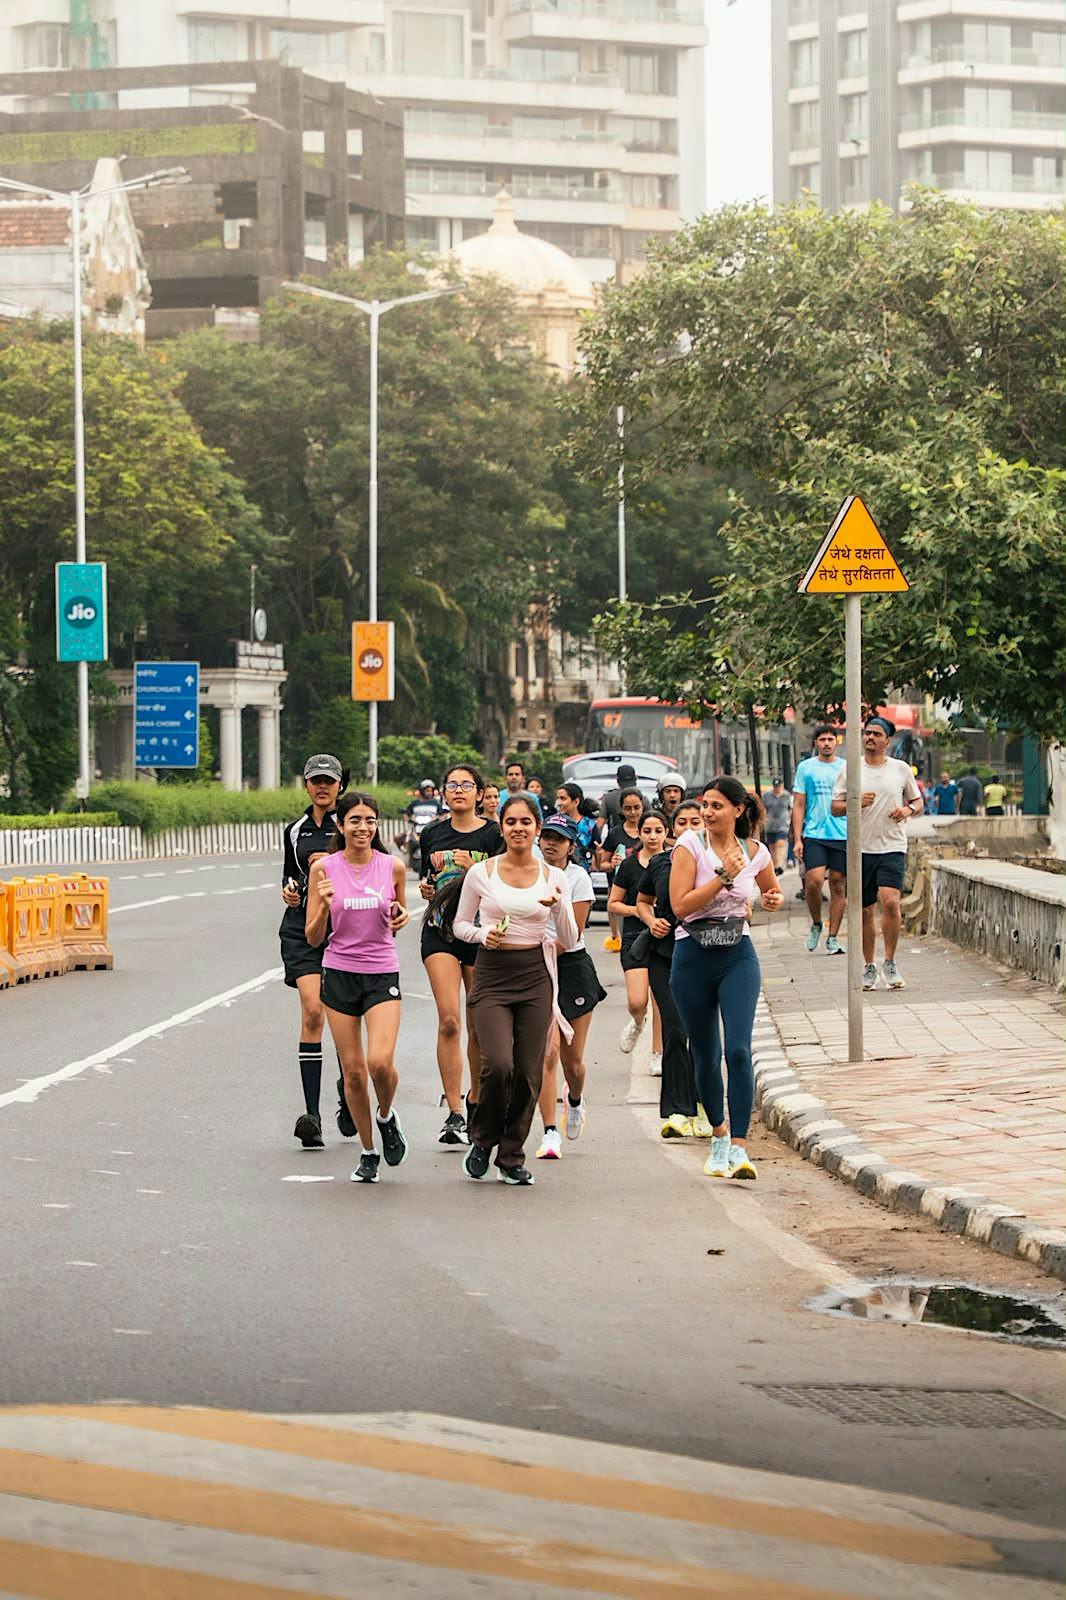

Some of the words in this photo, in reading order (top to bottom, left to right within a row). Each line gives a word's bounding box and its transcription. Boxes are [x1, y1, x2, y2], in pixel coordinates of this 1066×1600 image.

[830, 545, 852, 560] जेथे
[855, 548, 886, 560] दक्षता
[818, 566, 839, 581] तेथे
[842, 565, 896, 586] सुरक्षितता
[67, 603, 95, 620] Jio
[360, 655, 383, 669] Jio
[344, 897, 379, 911] PUMA
